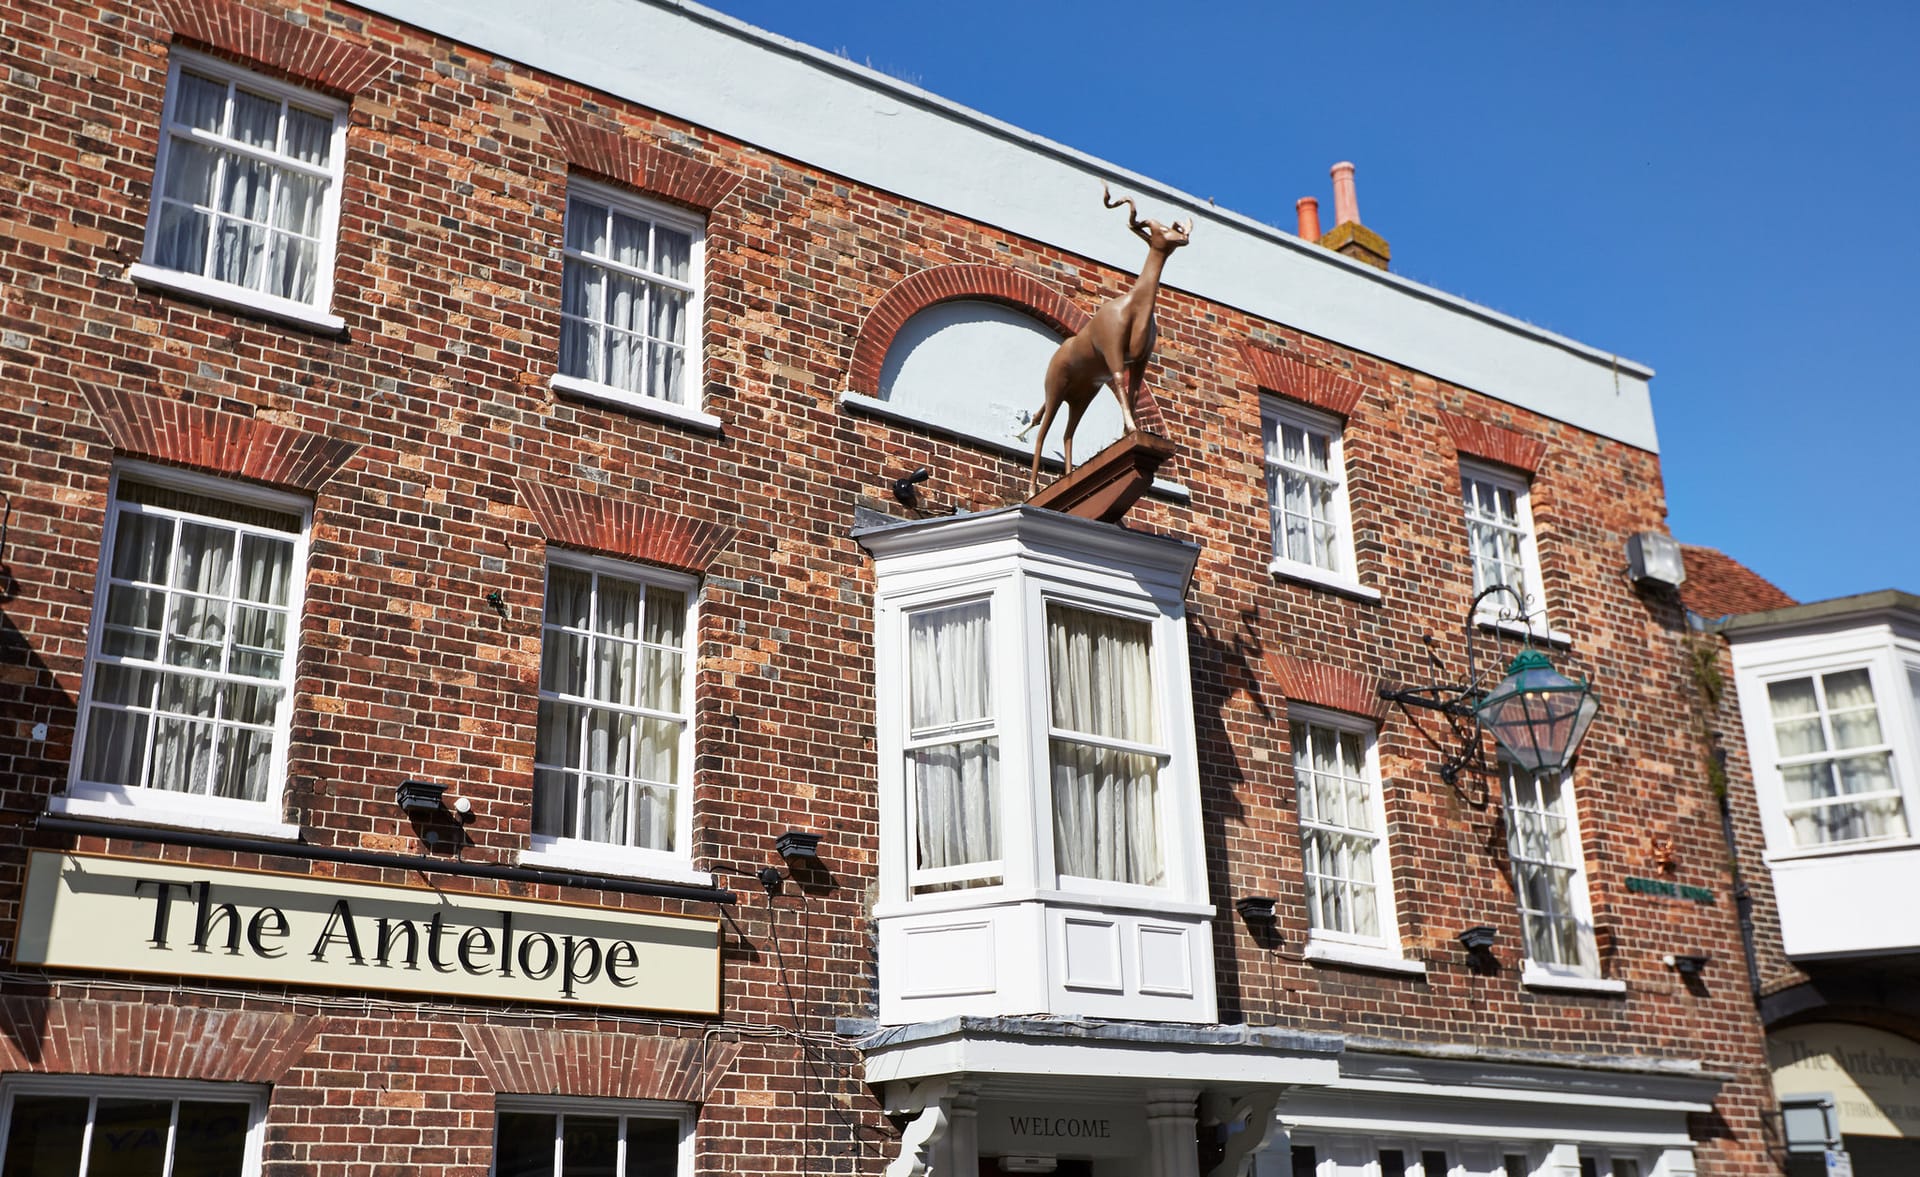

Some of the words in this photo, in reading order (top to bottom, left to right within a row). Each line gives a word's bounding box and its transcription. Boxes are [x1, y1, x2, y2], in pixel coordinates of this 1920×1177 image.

[134, 880, 288, 955] The
[308, 899, 638, 996] Antelope
[1785, 1039, 1828, 1070] The
[1009, 1116, 1111, 1138] WELCOME
